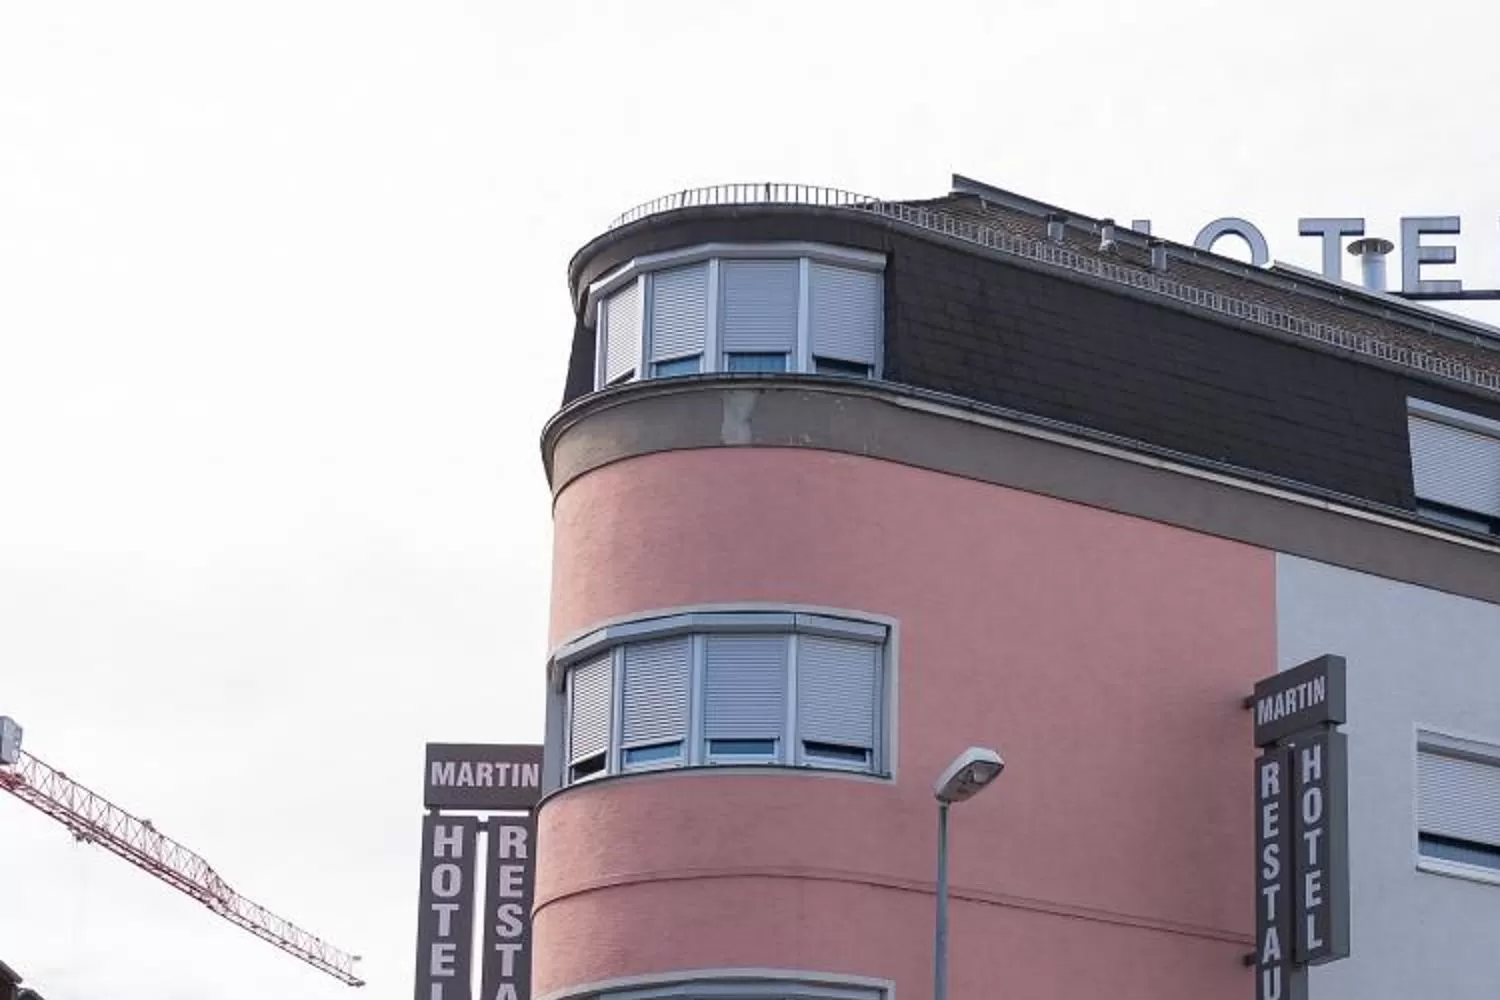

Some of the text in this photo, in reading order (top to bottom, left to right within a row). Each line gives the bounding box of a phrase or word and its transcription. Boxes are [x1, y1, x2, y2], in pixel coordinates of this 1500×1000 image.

[1257, 674, 1326, 726] MARTIN
[431, 761, 540, 788] MARTIN
[1300, 742, 1323, 949] HOTEL
